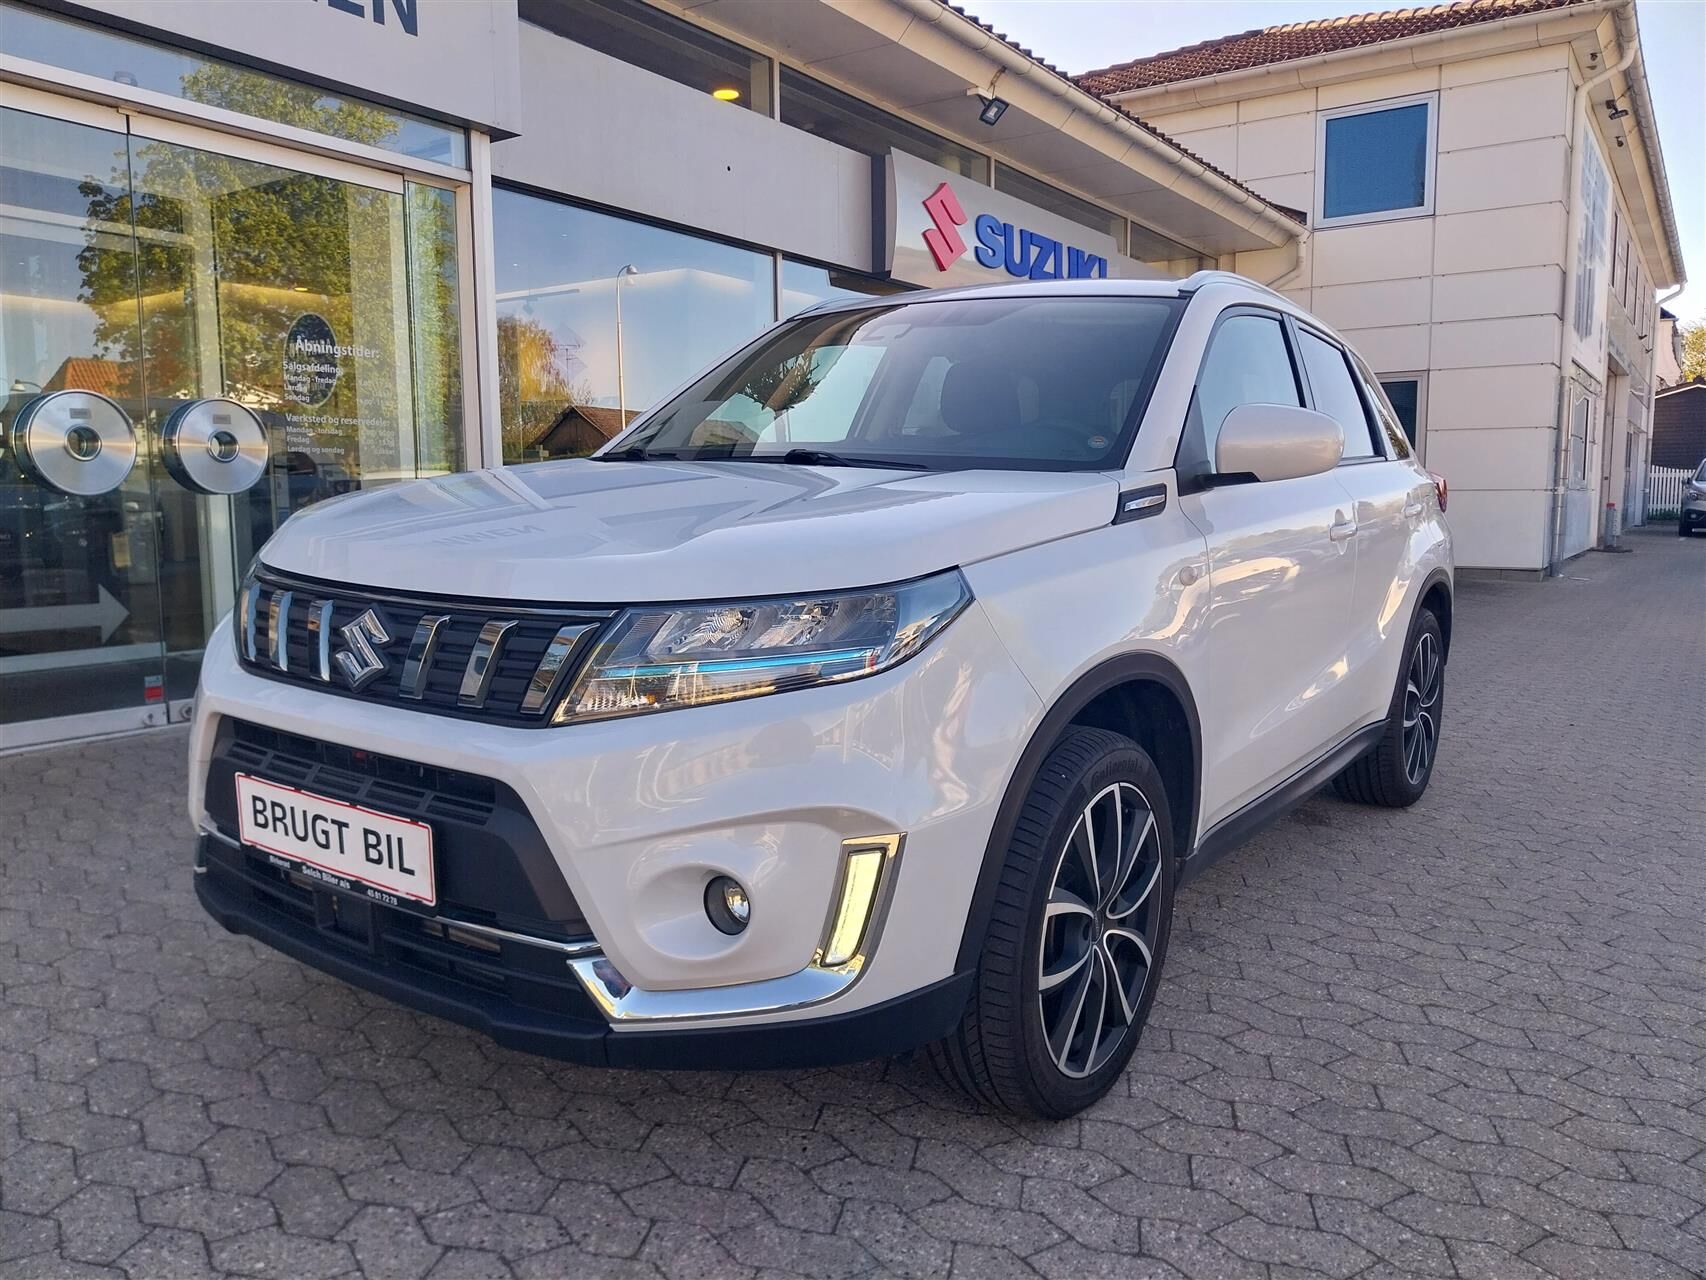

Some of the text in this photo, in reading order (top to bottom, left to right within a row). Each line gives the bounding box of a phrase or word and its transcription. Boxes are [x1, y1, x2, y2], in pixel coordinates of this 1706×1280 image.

[974, 213, 1107, 280] SUZUKI
[295, 335, 380, 358] Åbningstider:
[285, 413, 326, 423] Værksted
[328, 416, 339, 425] og
[286, 435, 310, 444] Fredag
[251, 794, 416, 877] BRUGT BIL
